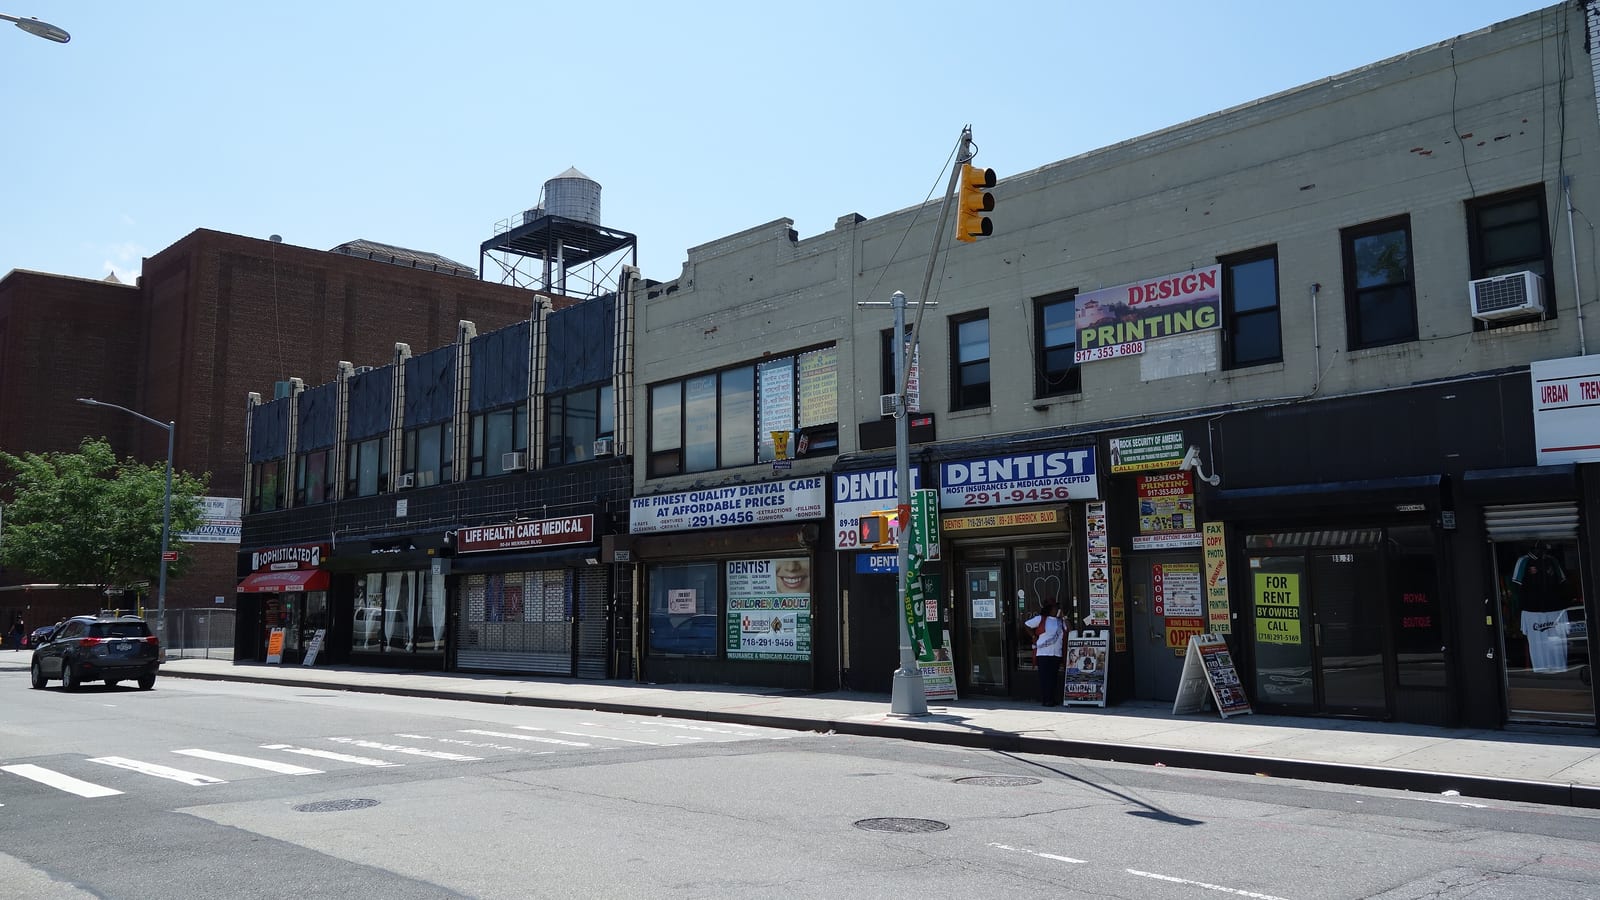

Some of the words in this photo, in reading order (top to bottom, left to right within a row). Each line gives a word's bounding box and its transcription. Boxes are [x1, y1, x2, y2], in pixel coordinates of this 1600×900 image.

[1128, 270, 1217, 306] DESIGN
[1081, 306, 1216, 349] PRINTING
[1541, 384, 1569, 404] URBAN
[1580, 381, 1600, 400] TREN
[1133, 436, 1155, 447] SECURITY
[1155, 436, 1161, 445] OF
[1162, 433, 1183, 444] AMERICA
[948, 450, 1088, 485] DENTIST
[1145, 473, 1185, 483] DESIGN
[946, 486, 964, 494] MOST
[966, 482, 1008, 492] INSURANCES
[1017, 479, 1052, 488] MEDICAID
[1054, 476, 1091, 486] ACCEPTED
[1141, 480, 1189, 490] PRINTING
[633, 498, 650, 509] THE
[653, 494, 687, 506] FINEST
[690, 488, 737, 503] QUALITY
[740, 482, 785, 497] DENTAL
[789, 478, 822, 491] CARE
[964, 486, 1070, 505] 291-9456
[657, 507, 670, 518] AT
[672, 501, 741, 517] AFFORDABLE
[745, 495, 785, 508] PRICES
[692, 512, 754, 528] 291-9456
[928, 491, 937, 542] DENTIST
[944, 520, 964, 529] DENTIST
[1015, 514, 1038, 524] MERRICK
[1041, 512, 1054, 522] BLVD
[840, 519, 859, 528] 89-28
[1207, 526, 1222, 534] FAX
[465, 530, 482, 543] LIFE
[483, 525, 515, 542] HEALTH
[517, 524, 540, 538] CARE
[542, 519, 583, 536] MEDICAL
[1207, 537, 1222, 546] COPY
[260, 548, 311, 566] SOPHISTICATED
[1208, 549, 1224, 558] PHOTO
[730, 561, 770, 574] DENTIST
[1026, 561, 1067, 573] DENTIST
[1266, 576, 1288, 589] FOR
[730, 599, 772, 609] CHILDREN
[774, 599, 780, 609] &
[781, 599, 809, 608] ADULT
[1263, 591, 1291, 604] RENT
[1404, 593, 1428, 603] ROYAL
[1210, 600, 1228, 610] PRINTING
[1211, 613, 1229, 621] BANNER
[1257, 607, 1268, 616] BY
[1269, 608, 1299, 618] OWNER
[1211, 624, 1229, 632] FLYER
[1268, 621, 1288, 632] CALL
[742, 638, 794, 647] 718-291-9456
[1259, 633, 1273, 641] (718)
